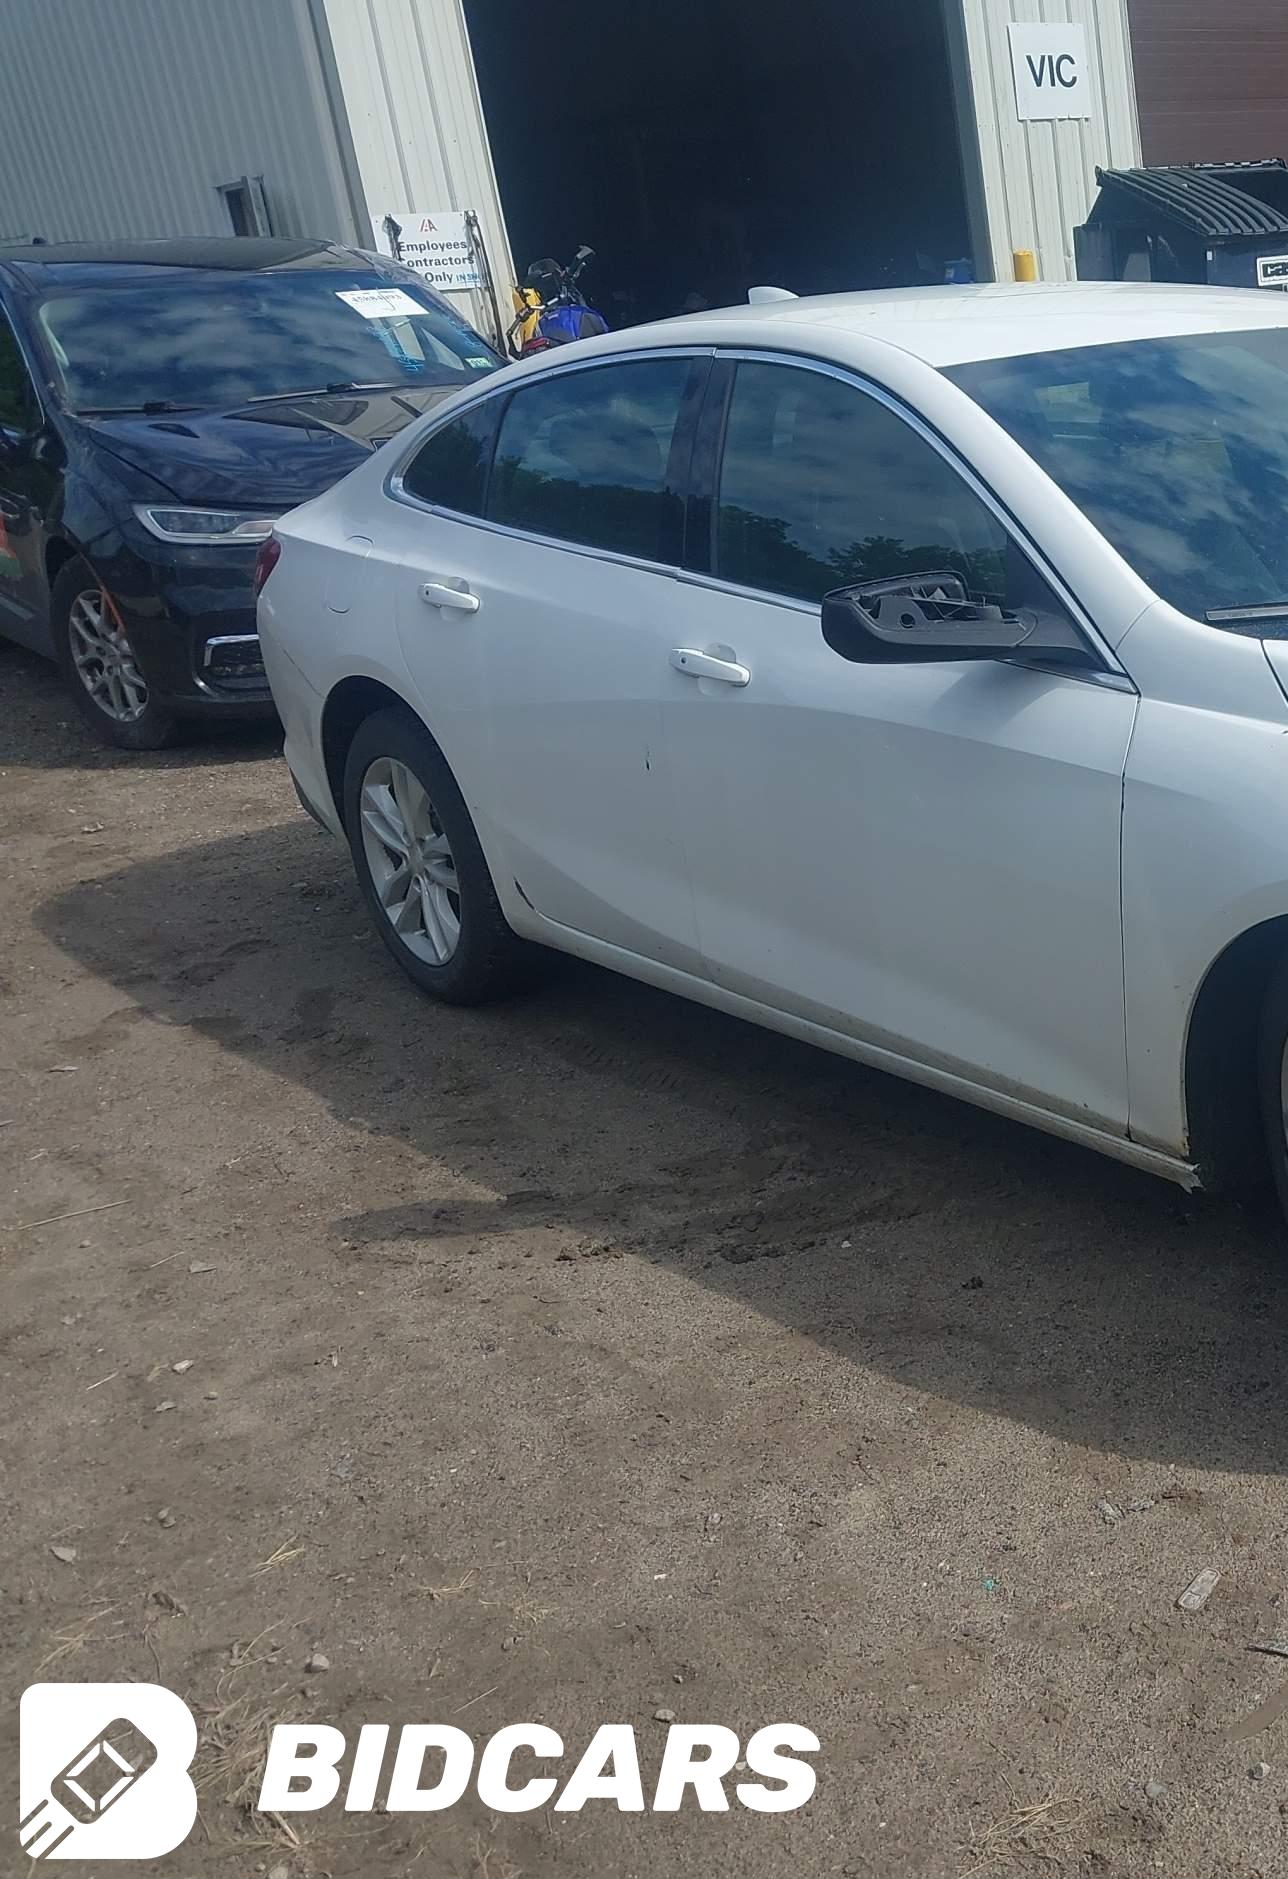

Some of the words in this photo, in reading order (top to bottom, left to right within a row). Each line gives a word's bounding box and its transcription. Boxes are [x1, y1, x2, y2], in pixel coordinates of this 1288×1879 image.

[1025, 53, 1078, 88] VIC
[398, 240, 468, 253] Employees
[424, 271, 454, 284] Only
